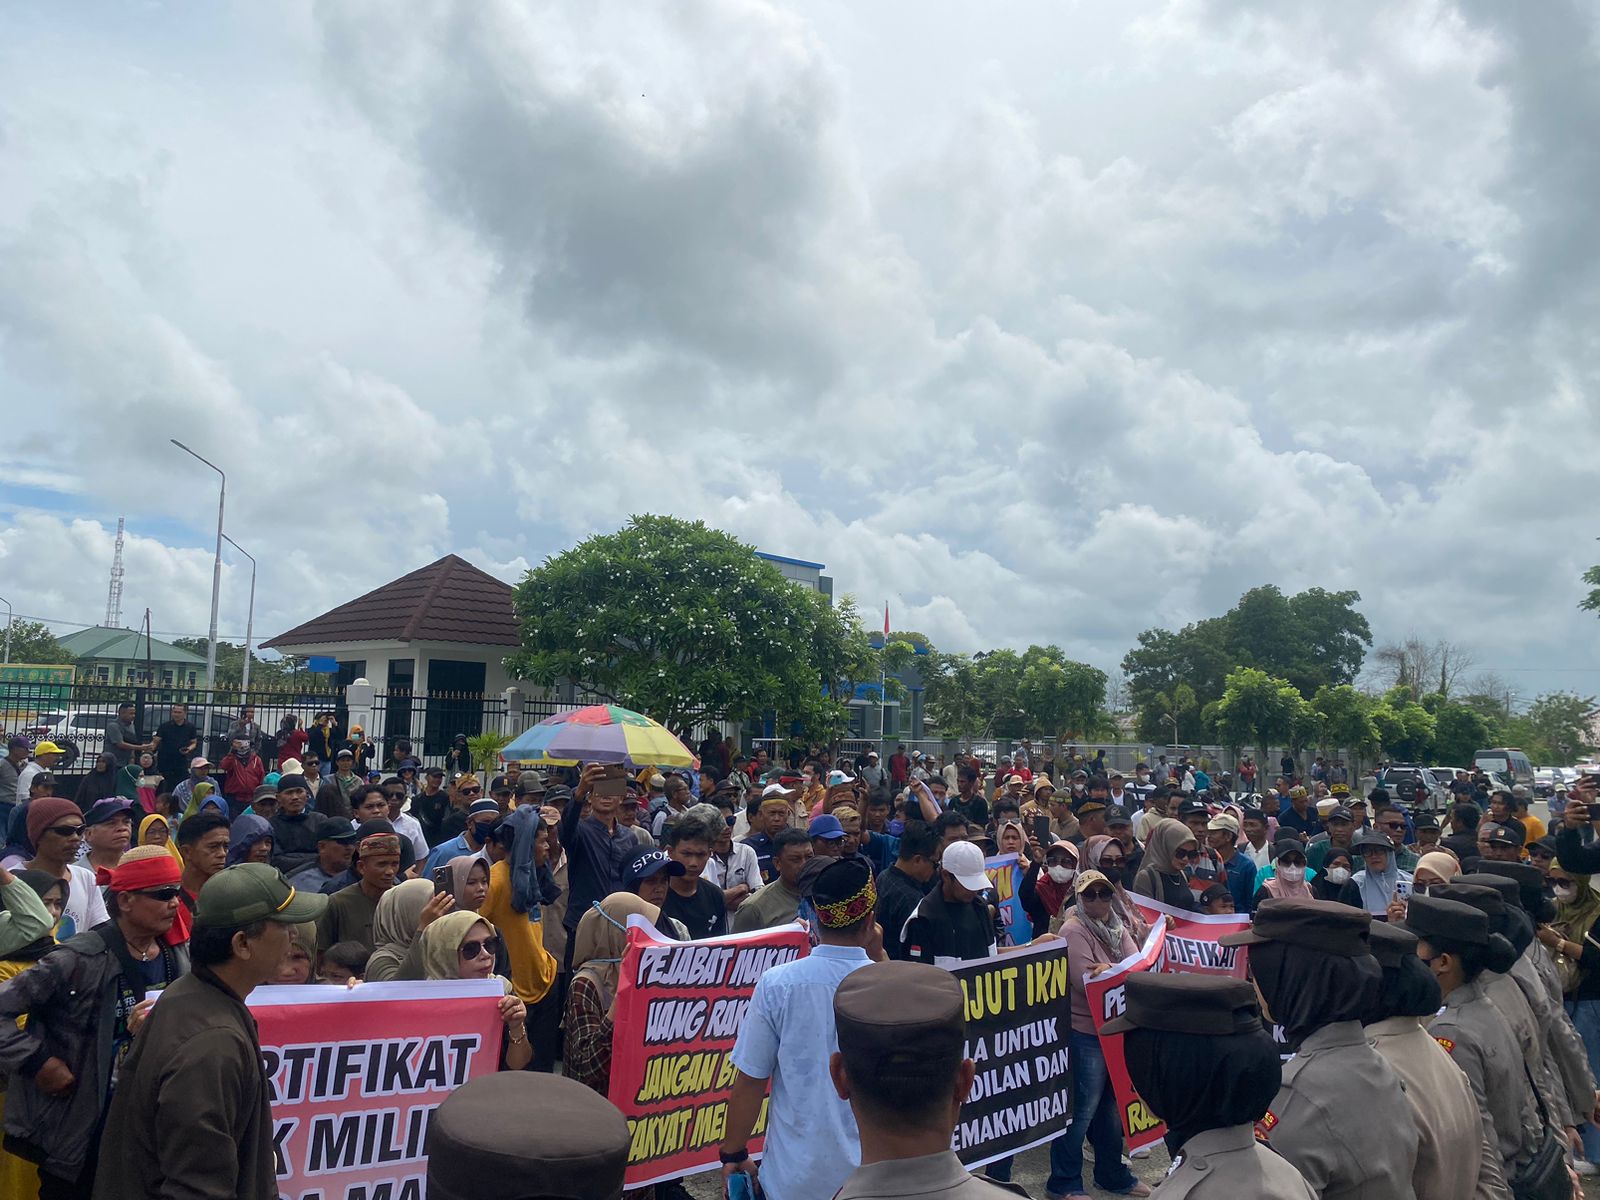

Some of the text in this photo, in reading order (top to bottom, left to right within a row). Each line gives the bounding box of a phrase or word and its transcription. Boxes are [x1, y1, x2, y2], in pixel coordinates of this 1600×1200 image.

[638, 947, 735, 986] PEJABAT
[1026, 956, 1068, 1007] IKN
[645, 999, 706, 1042] UANG
[994, 1016, 1059, 1058] UNTUK
[638, 1052, 720, 1101] JANGAN
[960, 1047, 1069, 1106] DILAN DAN
[308, 1108, 437, 1172] MILI
